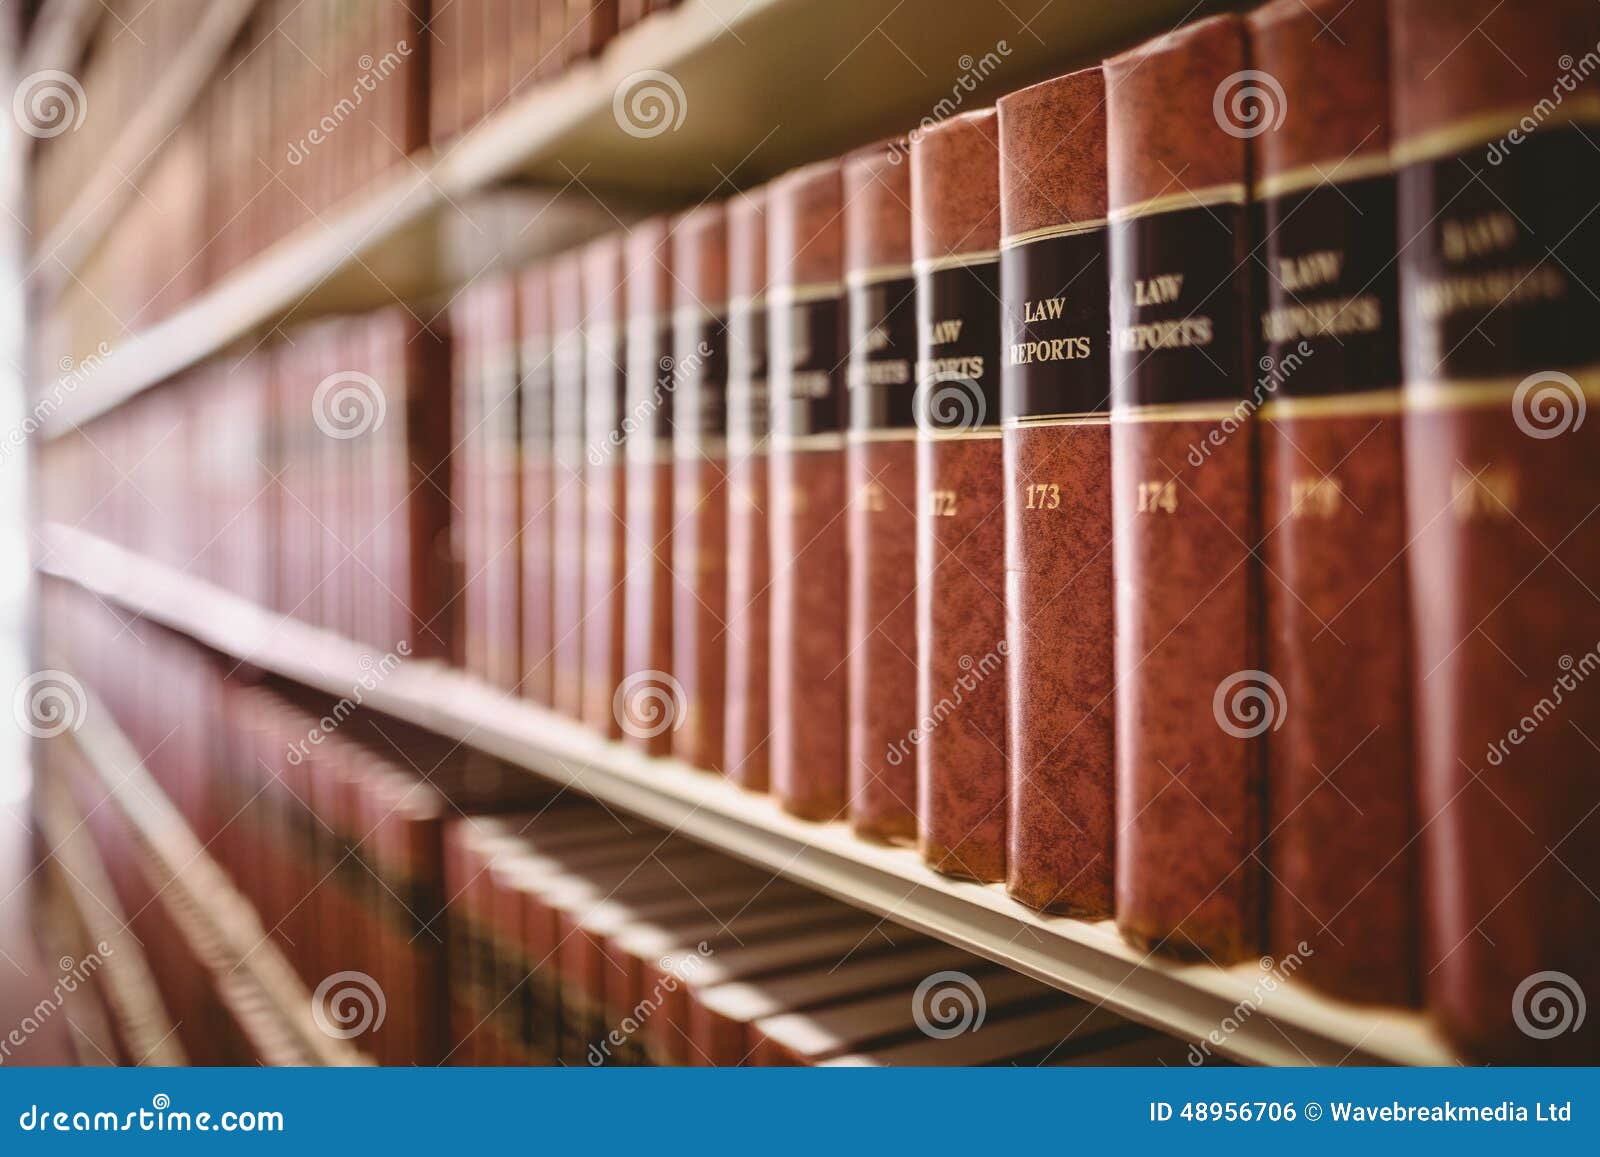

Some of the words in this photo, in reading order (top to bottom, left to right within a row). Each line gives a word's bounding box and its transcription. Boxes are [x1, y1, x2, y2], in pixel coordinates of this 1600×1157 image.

[1135, 274, 1183, 306] LAW
[1024, 297, 1066, 323] LAW
[928, 320, 963, 345] AW
[914, 356, 984, 384] PORTS
[1025, 484, 1060, 510] 173
[1137, 482, 1178, 513] 174
